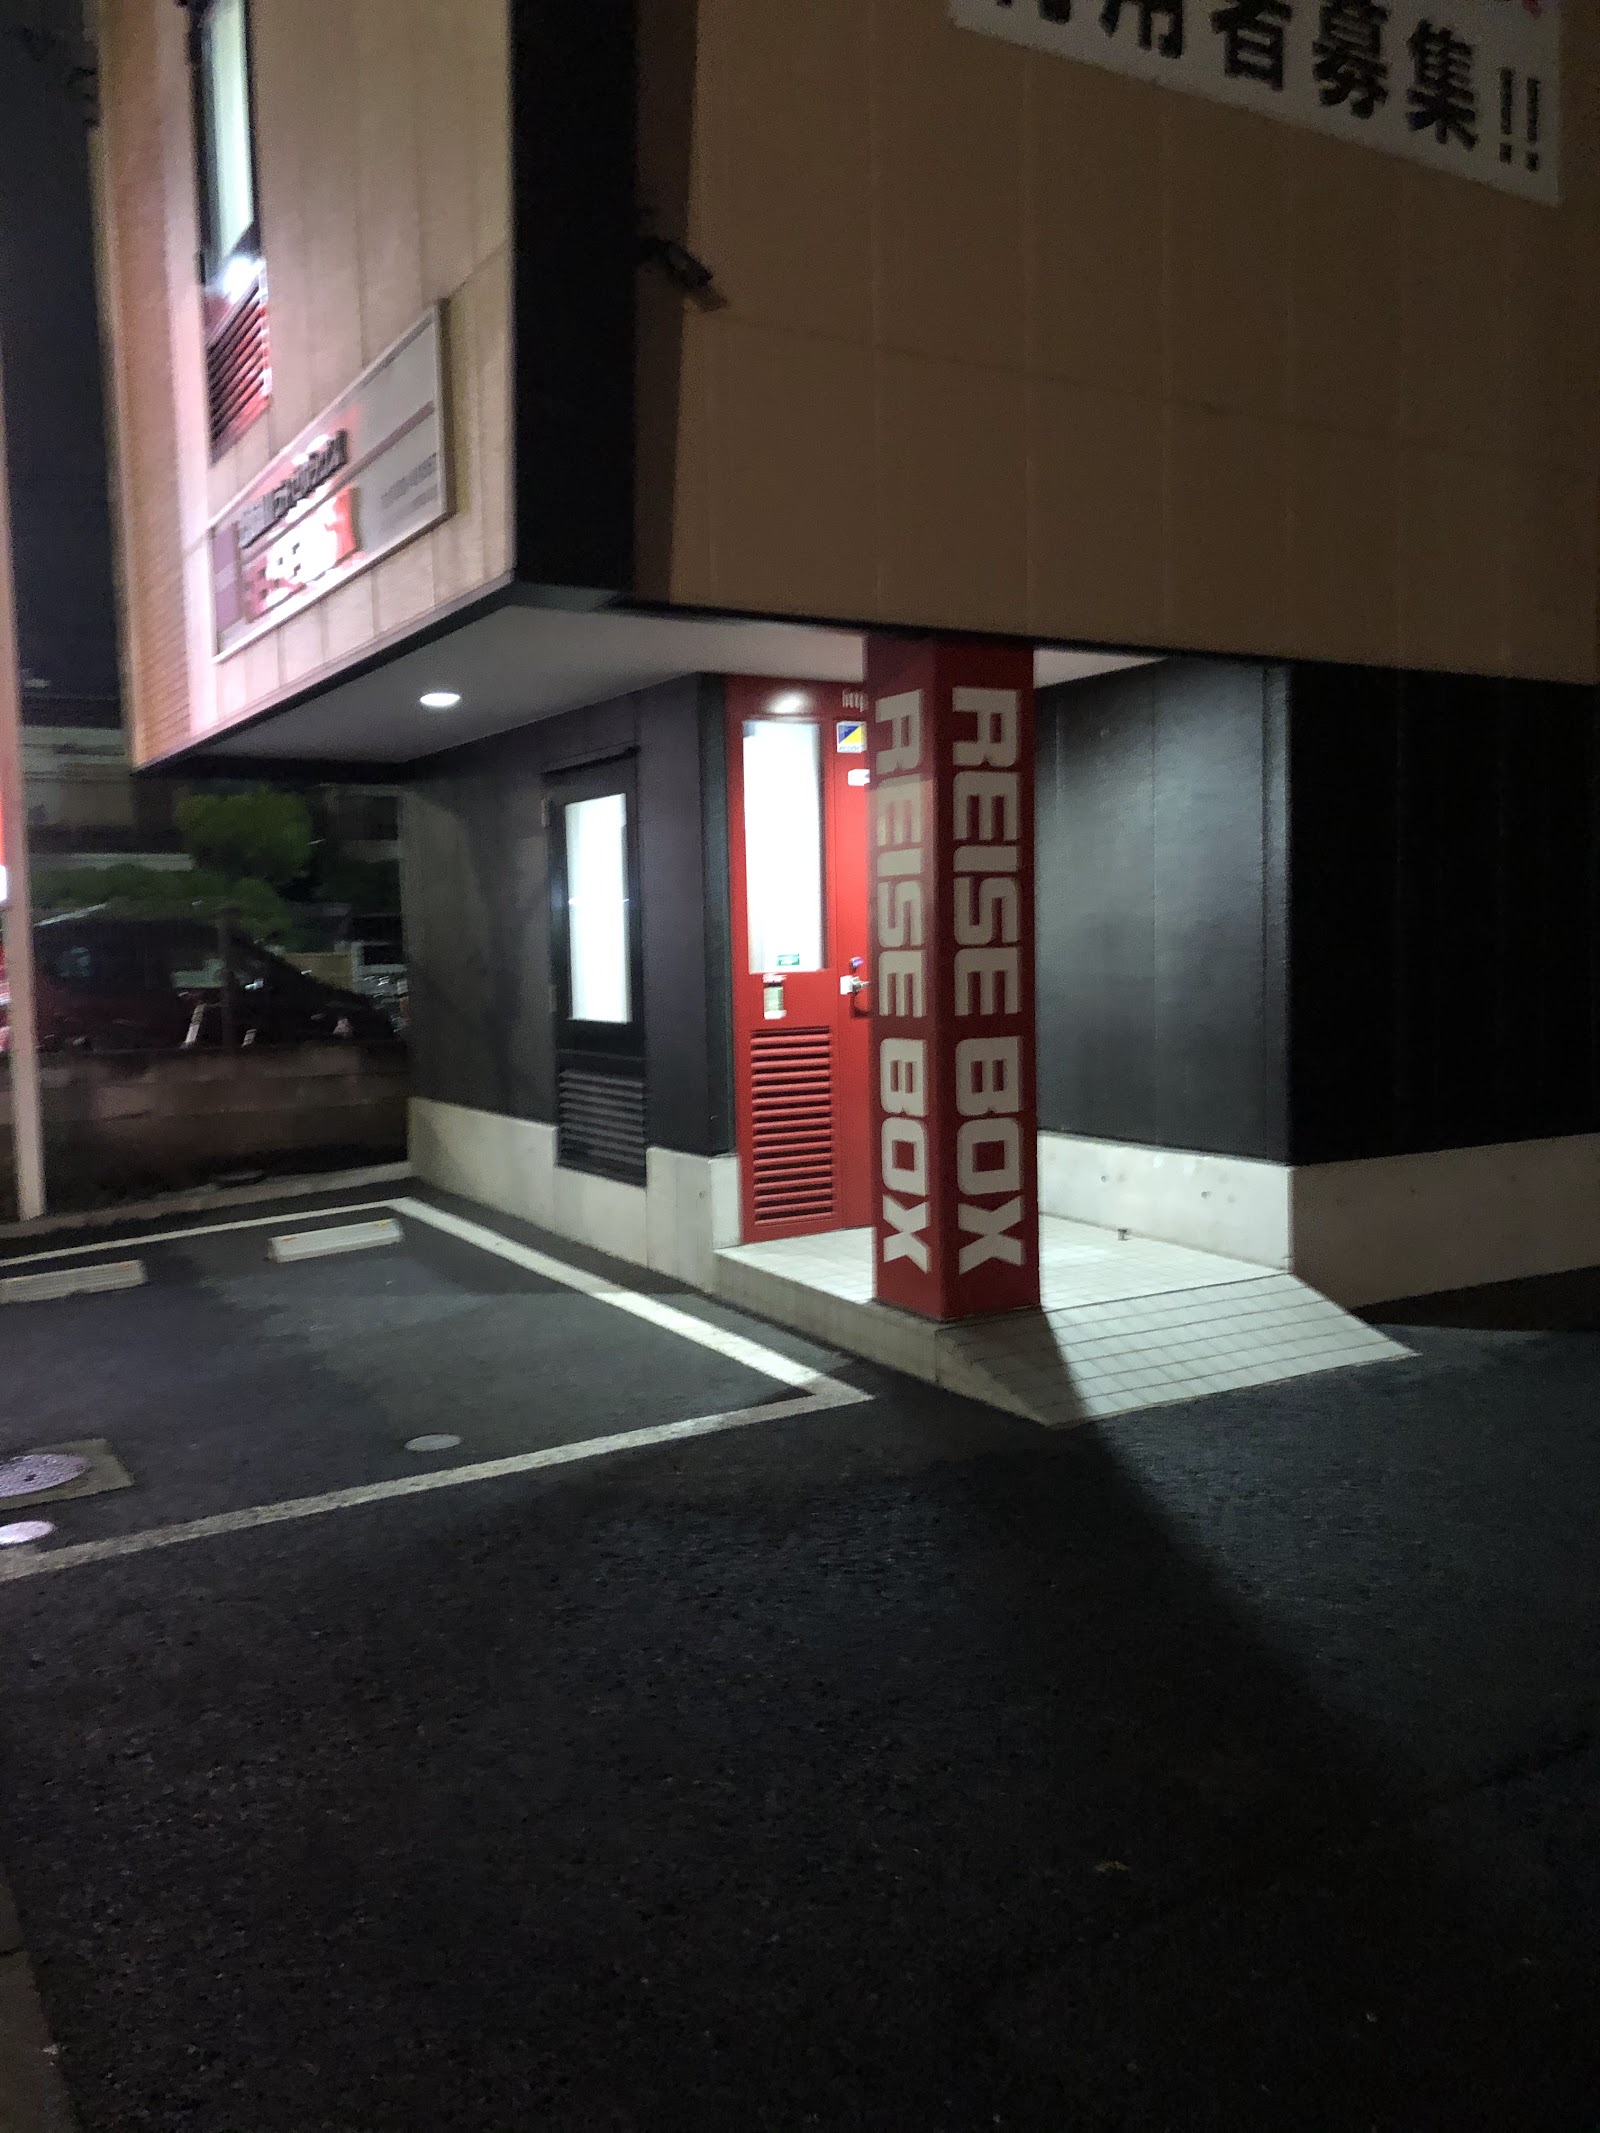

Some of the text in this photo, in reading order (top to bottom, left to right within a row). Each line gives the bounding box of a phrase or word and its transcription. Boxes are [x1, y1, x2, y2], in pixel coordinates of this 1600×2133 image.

[996, 0, 1542, 170] 者募集!!
[876, 689, 930, 1274] REISE BOX
[952, 686, 1025, 1275] REISE BOX
